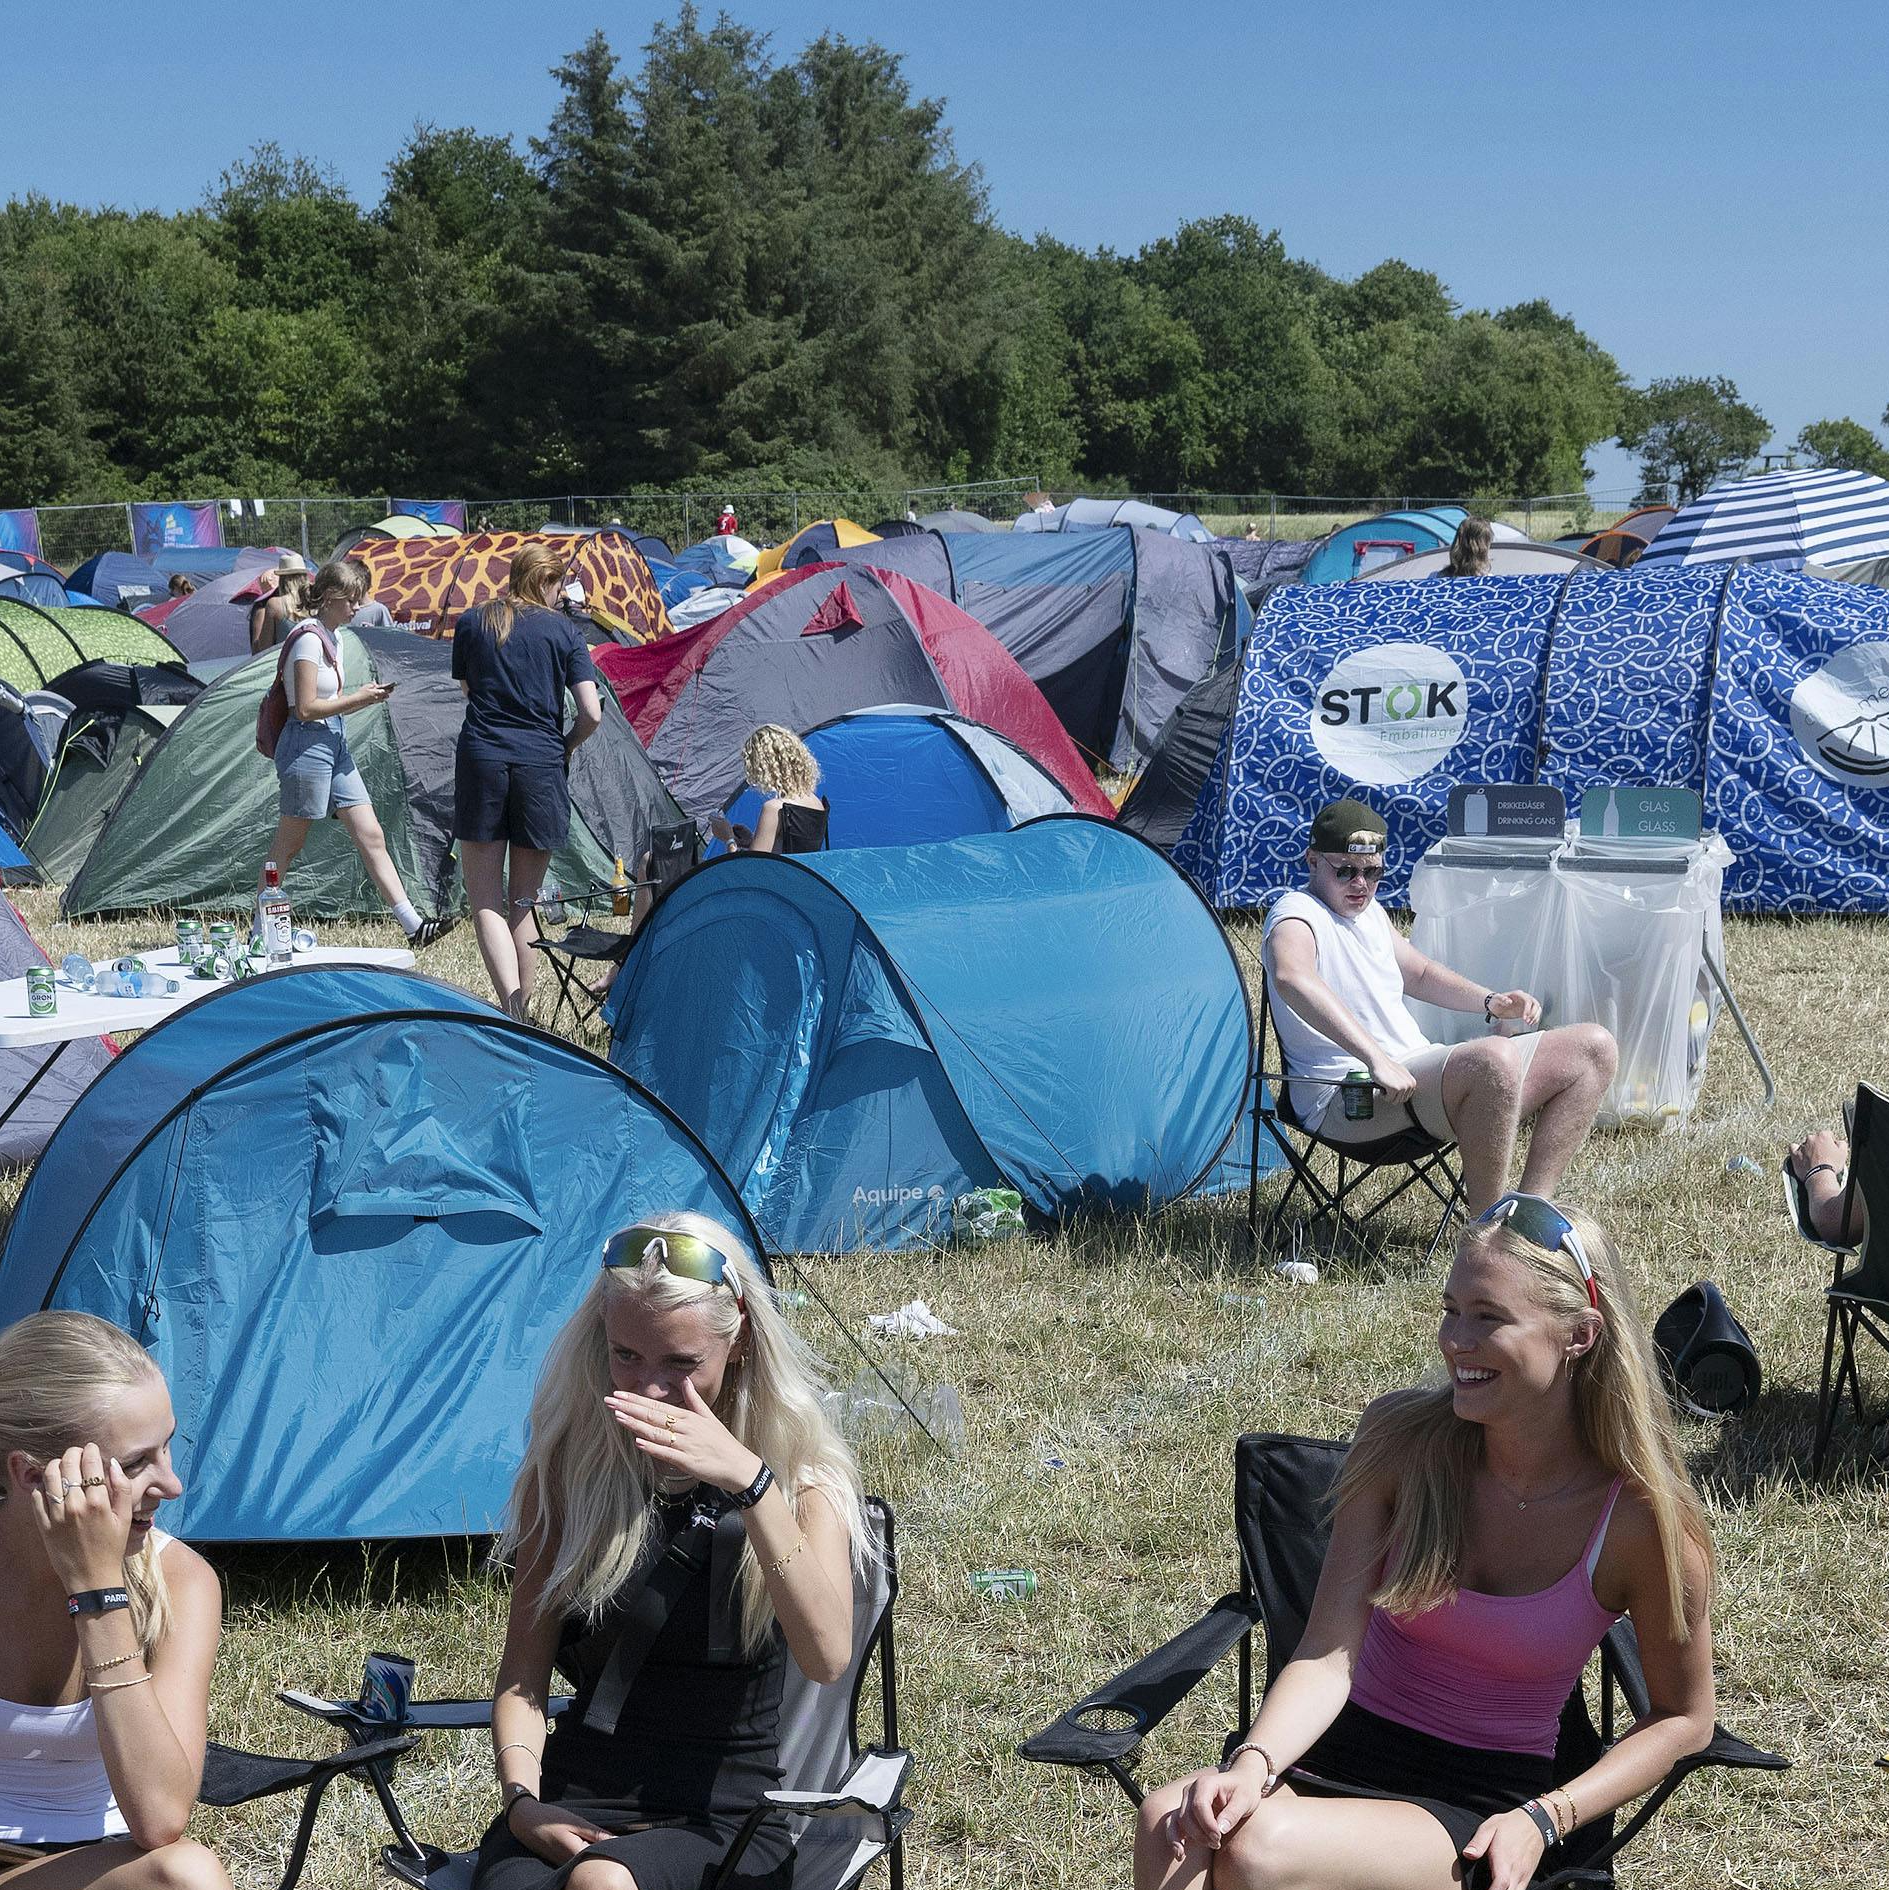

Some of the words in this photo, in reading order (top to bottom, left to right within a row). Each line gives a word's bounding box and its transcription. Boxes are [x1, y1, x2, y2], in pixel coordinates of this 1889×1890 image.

[1380, 726, 1457, 742] Emballage
[1497, 800, 1546, 810] DRIKKEDÅSER
[1638, 800, 1670, 813] GLAS
[1497, 816, 1533, 825] DRINKING
[1534, 816, 1557, 826] CANS
[1638, 821, 1676, 833] GLASS
[852, 1184, 924, 1207] Aquipe
